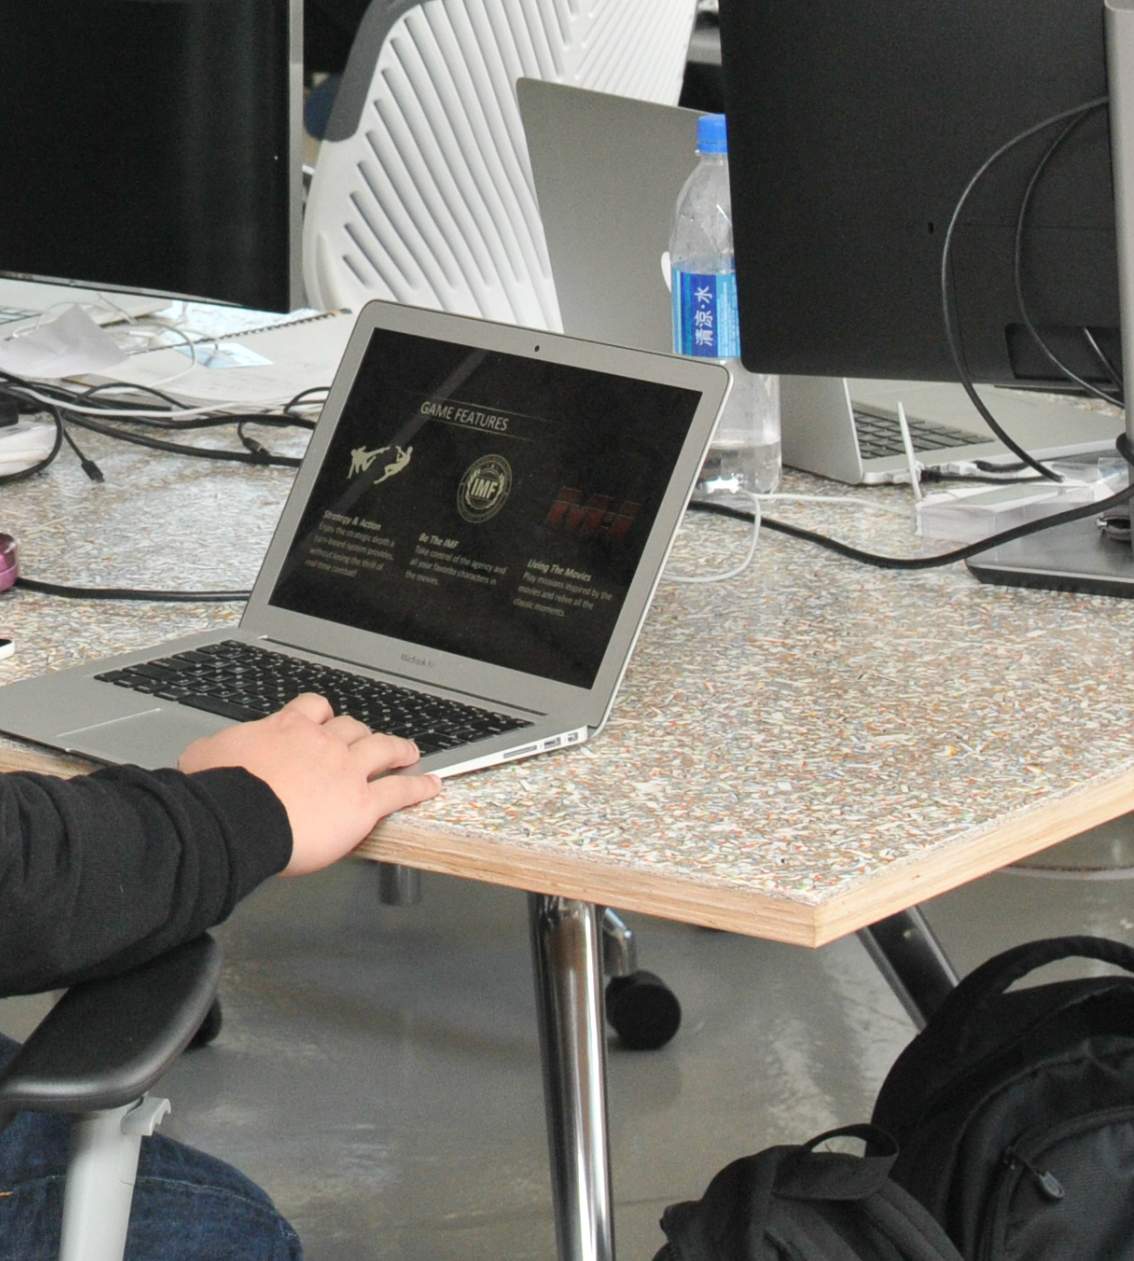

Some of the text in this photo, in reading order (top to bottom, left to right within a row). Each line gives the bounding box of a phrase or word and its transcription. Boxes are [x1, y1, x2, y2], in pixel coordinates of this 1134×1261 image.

[420, 401, 510, 431] GAME FEATURES
[471, 477, 499, 498] IMF
[324, 510, 352, 525] Strategy
[359, 519, 382, 531] Action
[419, 532, 460, 549] Be The IMF
[523, 571, 537, 583] Play
[527, 558, 592, 582] Living The Movies
